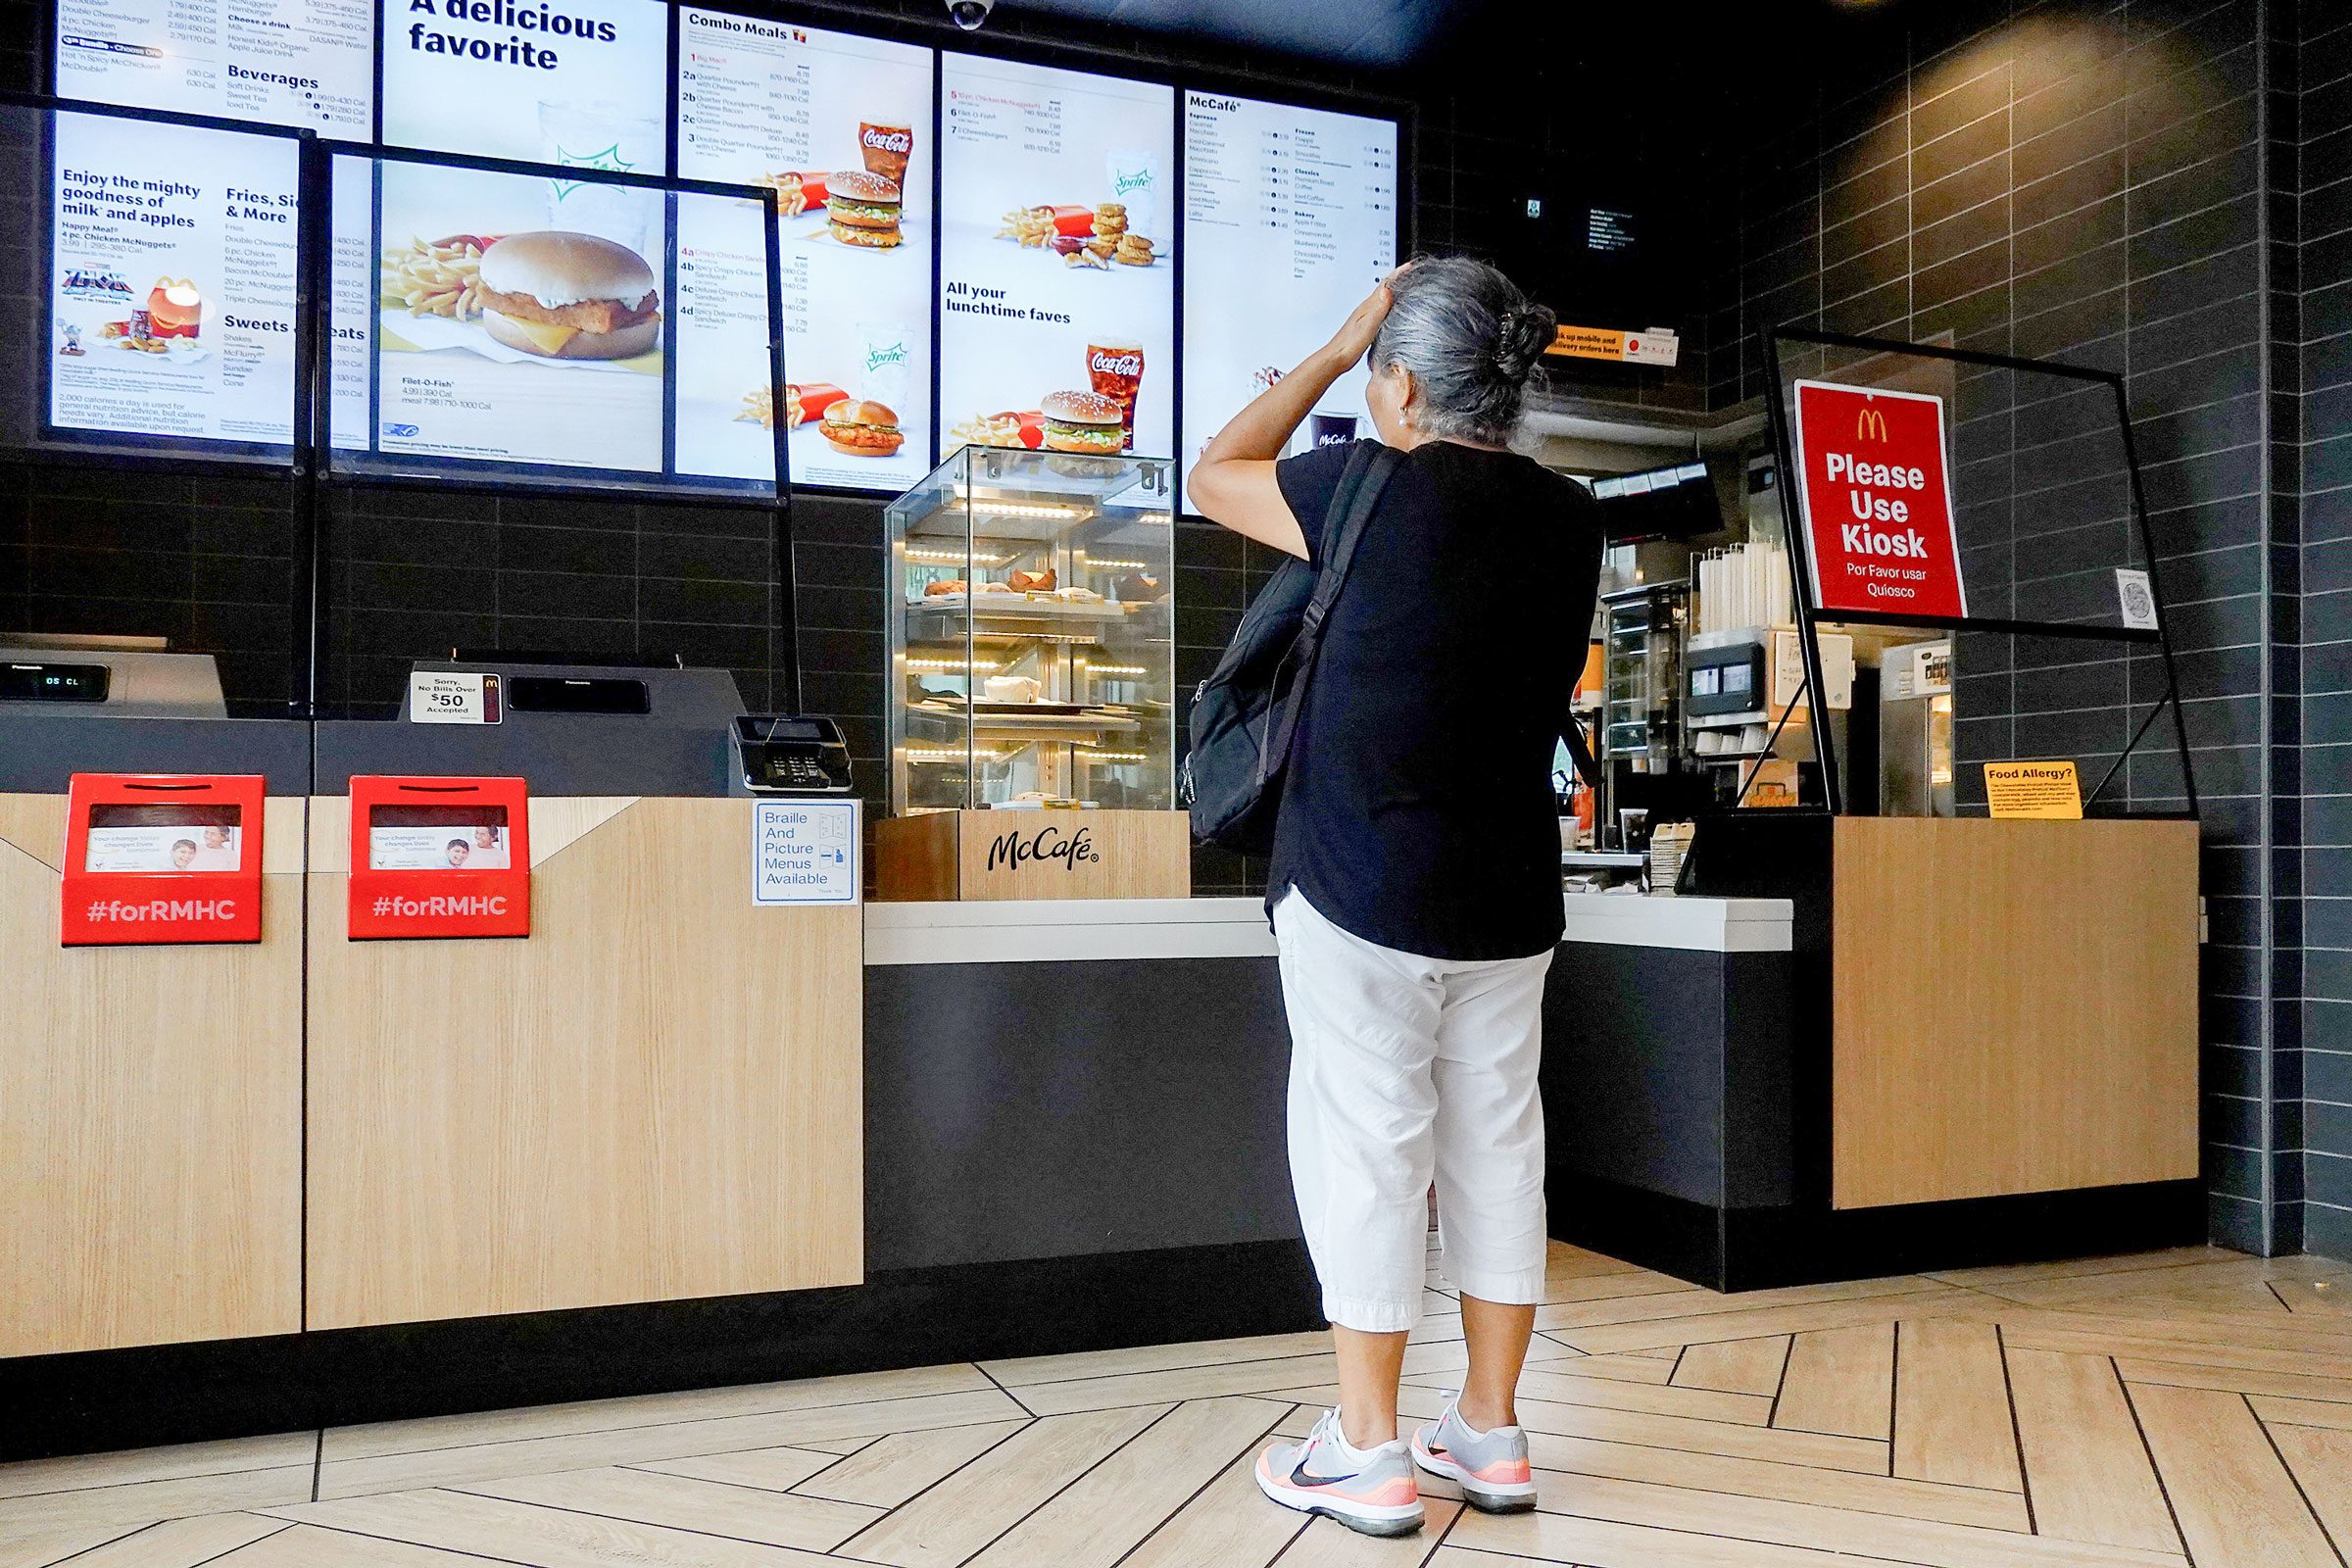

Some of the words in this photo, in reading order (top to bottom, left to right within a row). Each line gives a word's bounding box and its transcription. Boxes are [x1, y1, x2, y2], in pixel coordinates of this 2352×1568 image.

[228, 14, 260, 24] Choose
[269, 21, 291, 30] drink
[446, 0, 617, 42] delicious
[689, 13, 741, 32] Combo
[745, 23, 788, 40] Meals
[409, 23, 559, 70] favorite
[227, 65, 319, 89] Beverages
[682, 71, 696, 81] 2a
[682, 92, 696, 102] 2b
[682, 115, 696, 124] 2c
[951, 108, 957, 117] 6
[951, 125, 957, 134] 7
[688, 134, 695, 143] 3
[63, 169, 108, 188] Enjoy
[113, 175, 139, 189] the
[143, 179, 201, 199] mighty
[1116, 175, 1149, 190] Sprite
[63, 187, 143, 206] goodness
[148, 196, 165, 208] of
[226, 188, 274, 207] Fries,
[107, 209, 136, 220] and
[140, 214, 195, 228] apples
[226, 206, 238, 218] &
[244, 208, 287, 223] More
[62, 221, 90, 232] Happy
[84, 233, 121, 244] Chicken
[681, 263, 694, 271] 4b
[681, 284, 694, 293] 4c
[947, 281, 967, 295] All
[971, 286, 1006, 300] your
[680, 306, 694, 316] 4d
[947, 298, 1026, 319] lunchtime
[1030, 307, 1071, 324] faves
[224, 315, 289, 333] Sweets
[868, 349, 904, 365] Sprite
[1092, 352, 1141, 376] Coca-Cola
[59, 401, 91, 411] general
[93, 403, 129, 414] nutrition
[162, 408, 175, 416] but
[177, 410, 206, 419] calorie
[84, 396, 118, 405] calories
[126, 399, 141, 408] day
[59, 409, 84, 417] needs
[109, 413, 152, 422] Additional
[153, 416, 189, 425] nutrition
[59, 416, 109, 426] information
[111, 419, 147, 429] available
[149, 422, 171, 432] upon
[1826, 452, 1926, 492] Please
[1850, 490, 1909, 523] Use
[1841, 523, 1929, 560] Kiosk
[1846, 562, 1867, 577] Por
[1869, 564, 1900, 579] Favor
[1901, 567, 1927, 581] usar
[1988, 768, 2019, 779] Food
[2022, 768, 2073, 781] Allergy?
[765, 811, 808, 824] Braille
[765, 827, 795, 839] And
[764, 843, 813, 855] Picture
[764, 858, 811, 869] Menus
[765, 873, 828, 885] Available
[86, 900, 236, 922] #forRMHC
[372, 896, 508, 916] #forRMHC
